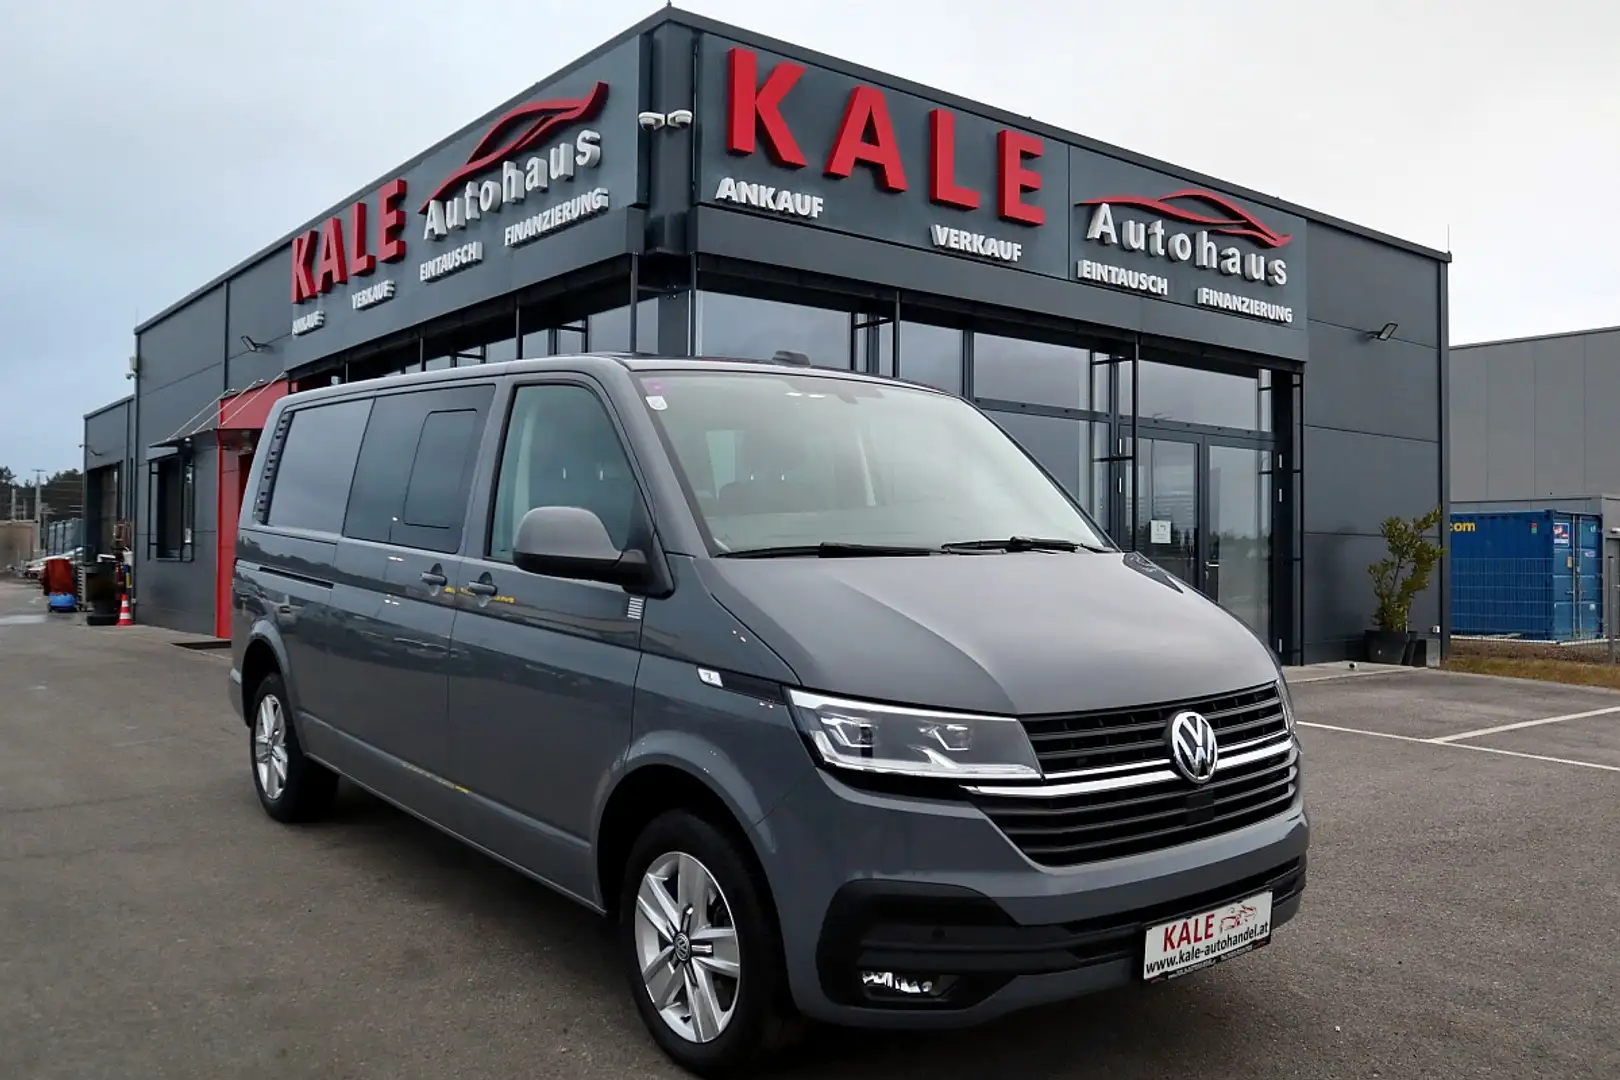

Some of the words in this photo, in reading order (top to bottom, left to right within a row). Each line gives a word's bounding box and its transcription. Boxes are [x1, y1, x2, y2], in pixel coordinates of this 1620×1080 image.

[727, 47, 1045, 227] KALE
[424, 129, 601, 240] Autohaus
[714, 177, 824, 219] ANKAUF
[504, 187, 609, 247] FINANZIERUNG
[292, 178, 406, 304] KALE
[420, 241, 483, 282] EINTAUSCH
[930, 224, 1022, 262] VERKAUF
[1086, 202, 1288, 286] Autohaus
[1077, 259, 1168, 296] EINTAUSCH
[1197, 287, 1292, 323] FINANZIERUNG
[1146, 921, 1269, 974] www.kale-autohandel.at
[1163, 913, 1215, 952] KALE
